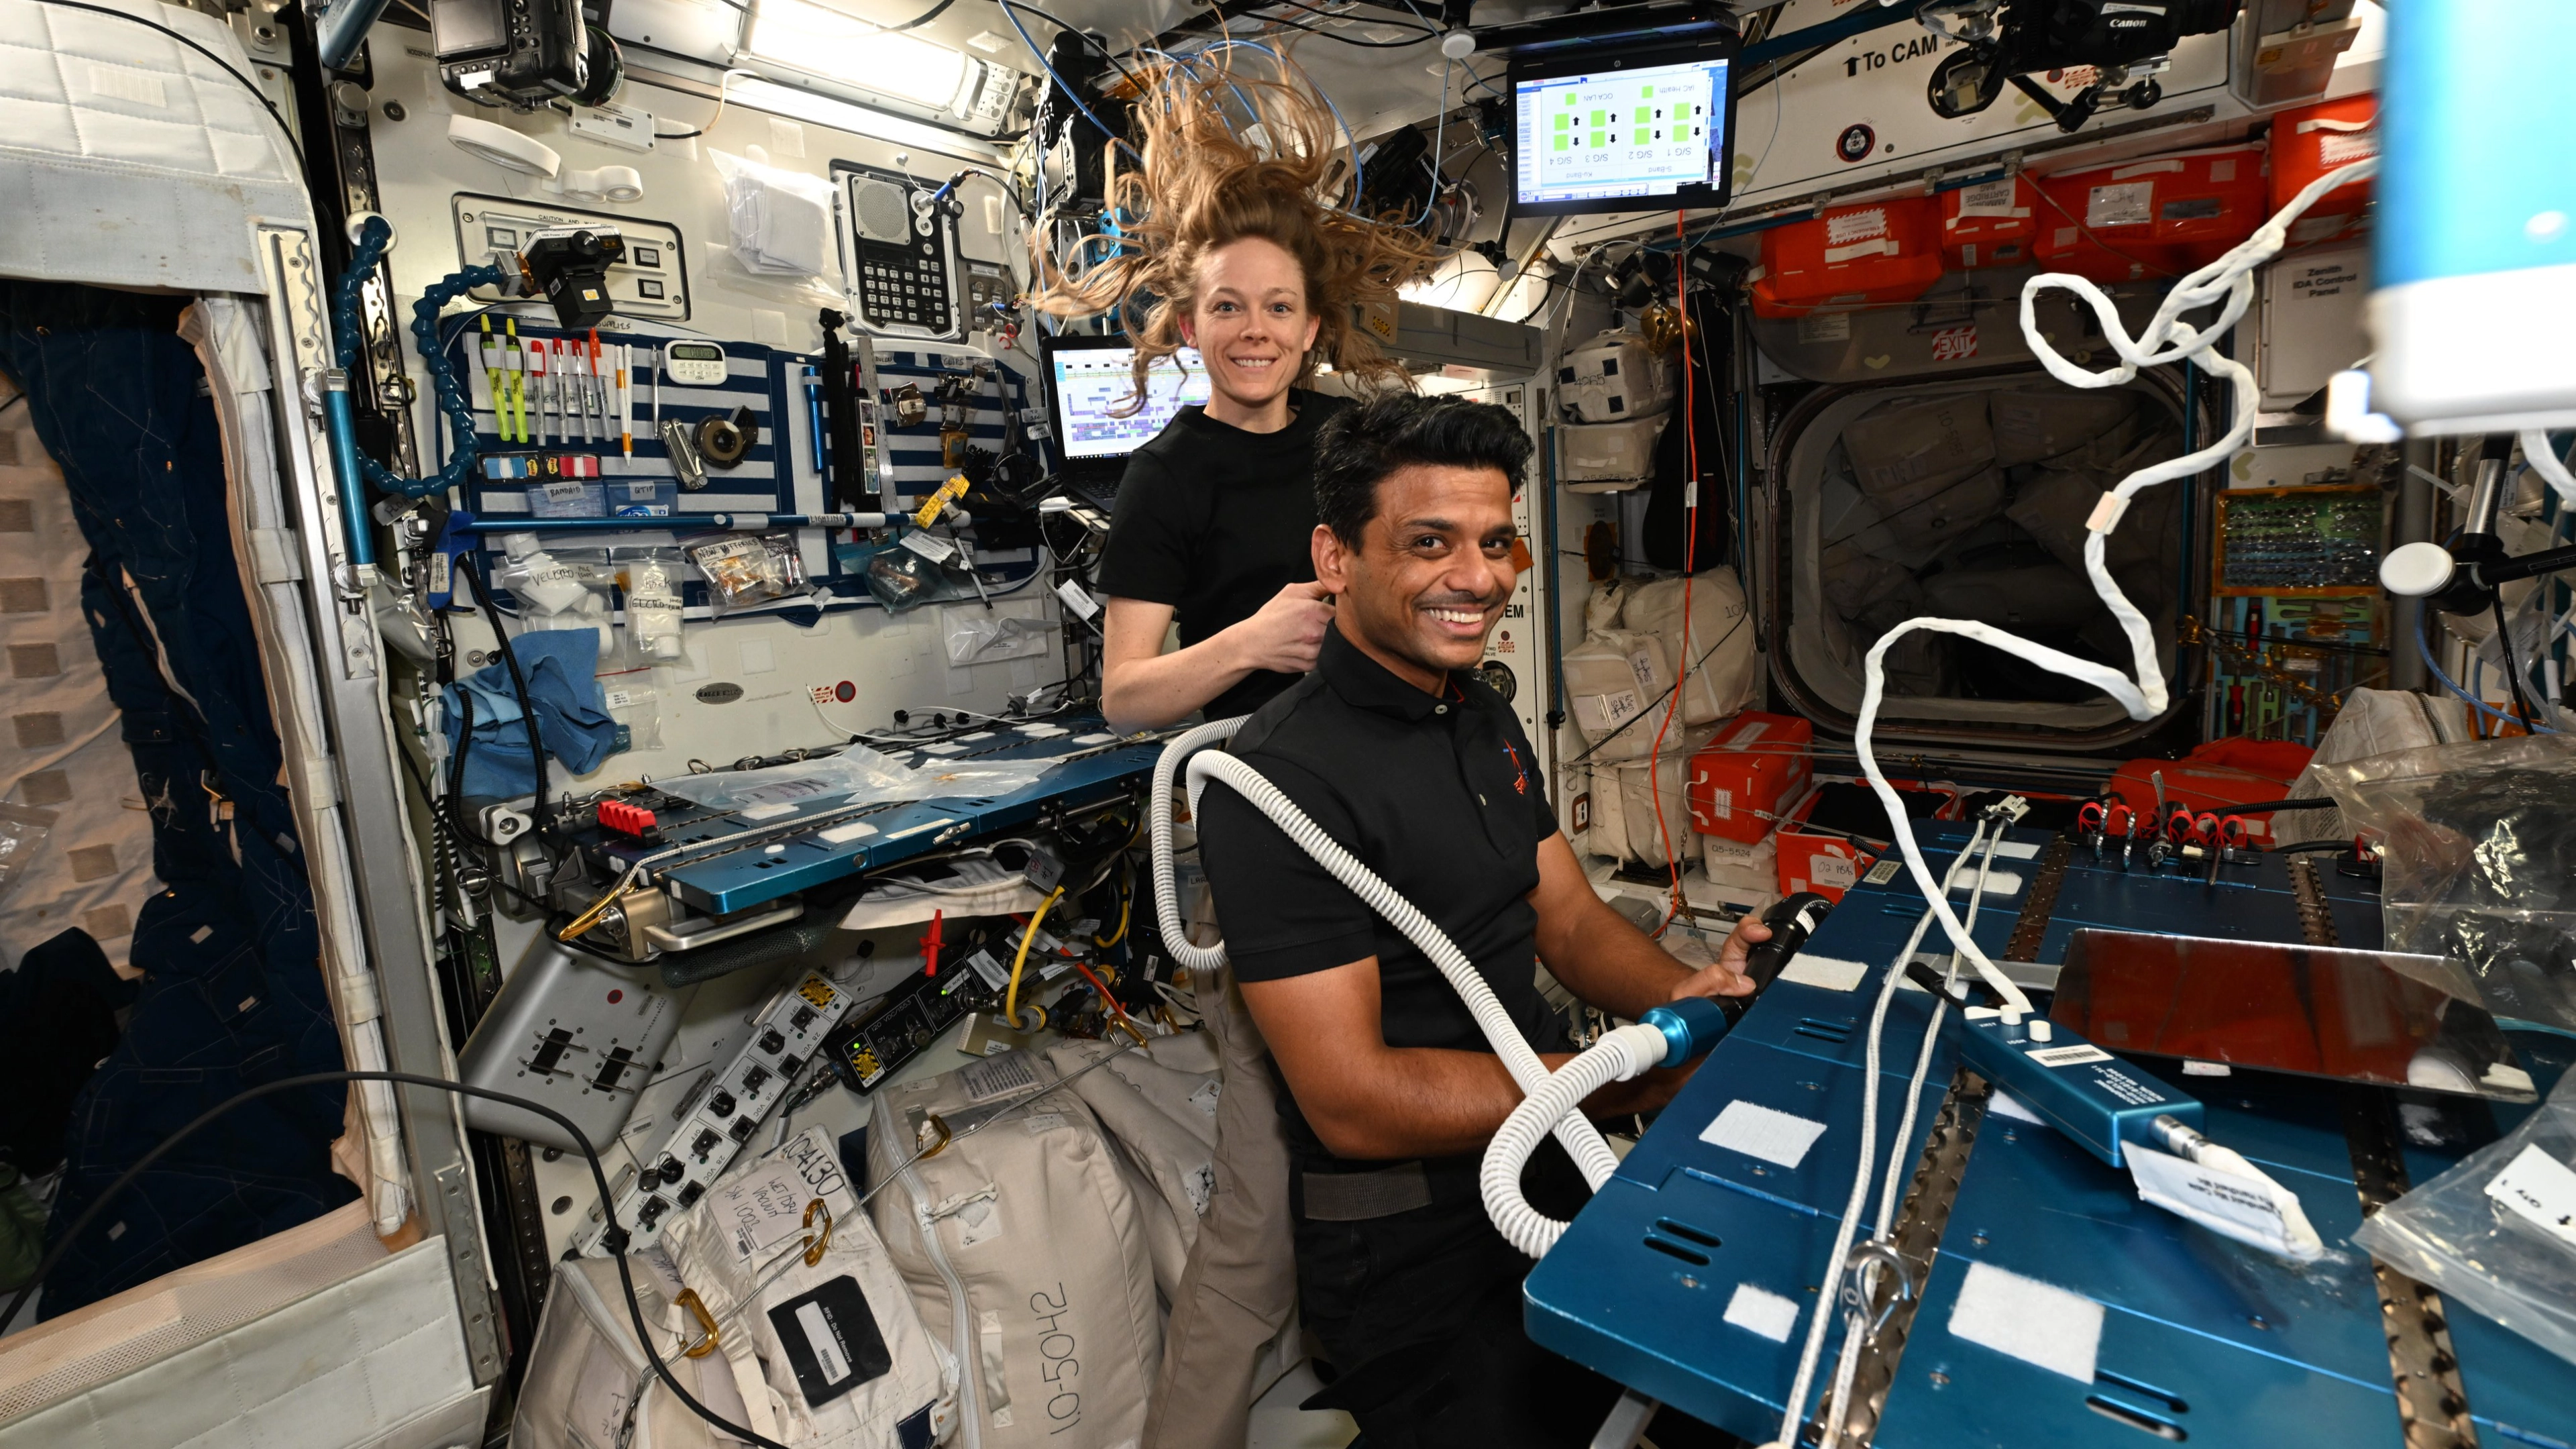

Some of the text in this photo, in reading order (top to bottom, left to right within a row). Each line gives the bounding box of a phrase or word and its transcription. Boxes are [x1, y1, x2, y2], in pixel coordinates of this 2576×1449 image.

[2109, 19, 2147, 28] Canon
[1863, 34, 1937, 71] To CAM
[1628, 150, 1652, 159] S/G 2
[1673, 147, 1691, 156] S/G
[1556, 156, 1572, 165] S/G
[1592, 154, 1608, 162] S/G
[1966, 190, 2009, 202] CARTRIDGE
[538, 215, 564, 223] CAUTION
[1847, 226, 1881, 237] EMERGENCY
[2308, 265, 2342, 277] Zenith
[2293, 273, 2357, 289] IDA Control
[2309, 286, 2340, 297] Panel
[1939, 336, 1969, 353] EXIT
[943, 357, 964, 365] CLIPS
[550, 486, 581, 497] BANDAID
[635, 486, 653, 494] QTIP
[810, 515, 845, 523] LIGHTING
[699, 690, 740, 698] ORECK
[941, 968, 953, 979] VDC
[790, 1006, 798, 1017] OFF
[871, 1000, 912, 1032] 120 VDC/1553
[800, 1032, 820, 1055] 28 VDC
[849, 1046, 863, 1059] POWER
[741, 1066, 751, 1077] OFF
[864, 1067, 884, 1085] S/N 1017
[753, 1092, 774, 1117] 28 VDC
[729, 1118, 737, 1126] CB2
[691, 1129, 701, 1141] OFF
[704, 1155, 725, 1181] 28 VDC
[677, 1183, 686, 1191] CB3
[637, 1196, 647, 1209] OFF
[823, 1307, 833, 1320] RFID
[831, 1322, 838, 1332] Do
[835, 1330, 844, 1341] Not
[839, 1340, 853, 1363] Remove
